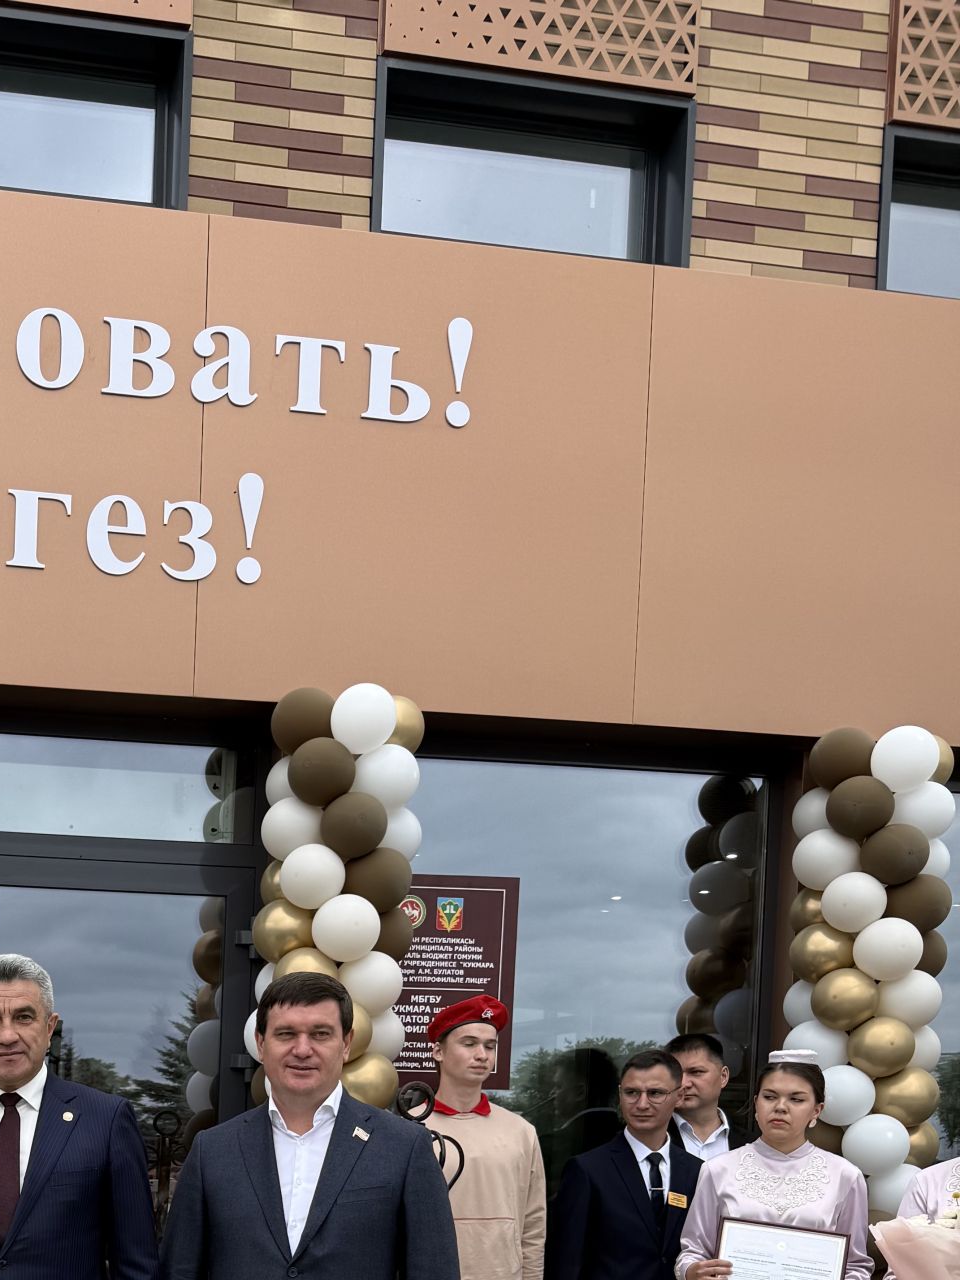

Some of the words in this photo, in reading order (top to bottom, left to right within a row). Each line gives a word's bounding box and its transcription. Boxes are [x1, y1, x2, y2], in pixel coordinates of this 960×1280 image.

[409, 944, 453, 952] УНИЦИПАЛЬ
[410, 995, 442, 1003] МБГБУ
[393, 1005, 431, 1013] УКМАРА
[399, 1015, 430, 1023] ЛАТОВ
